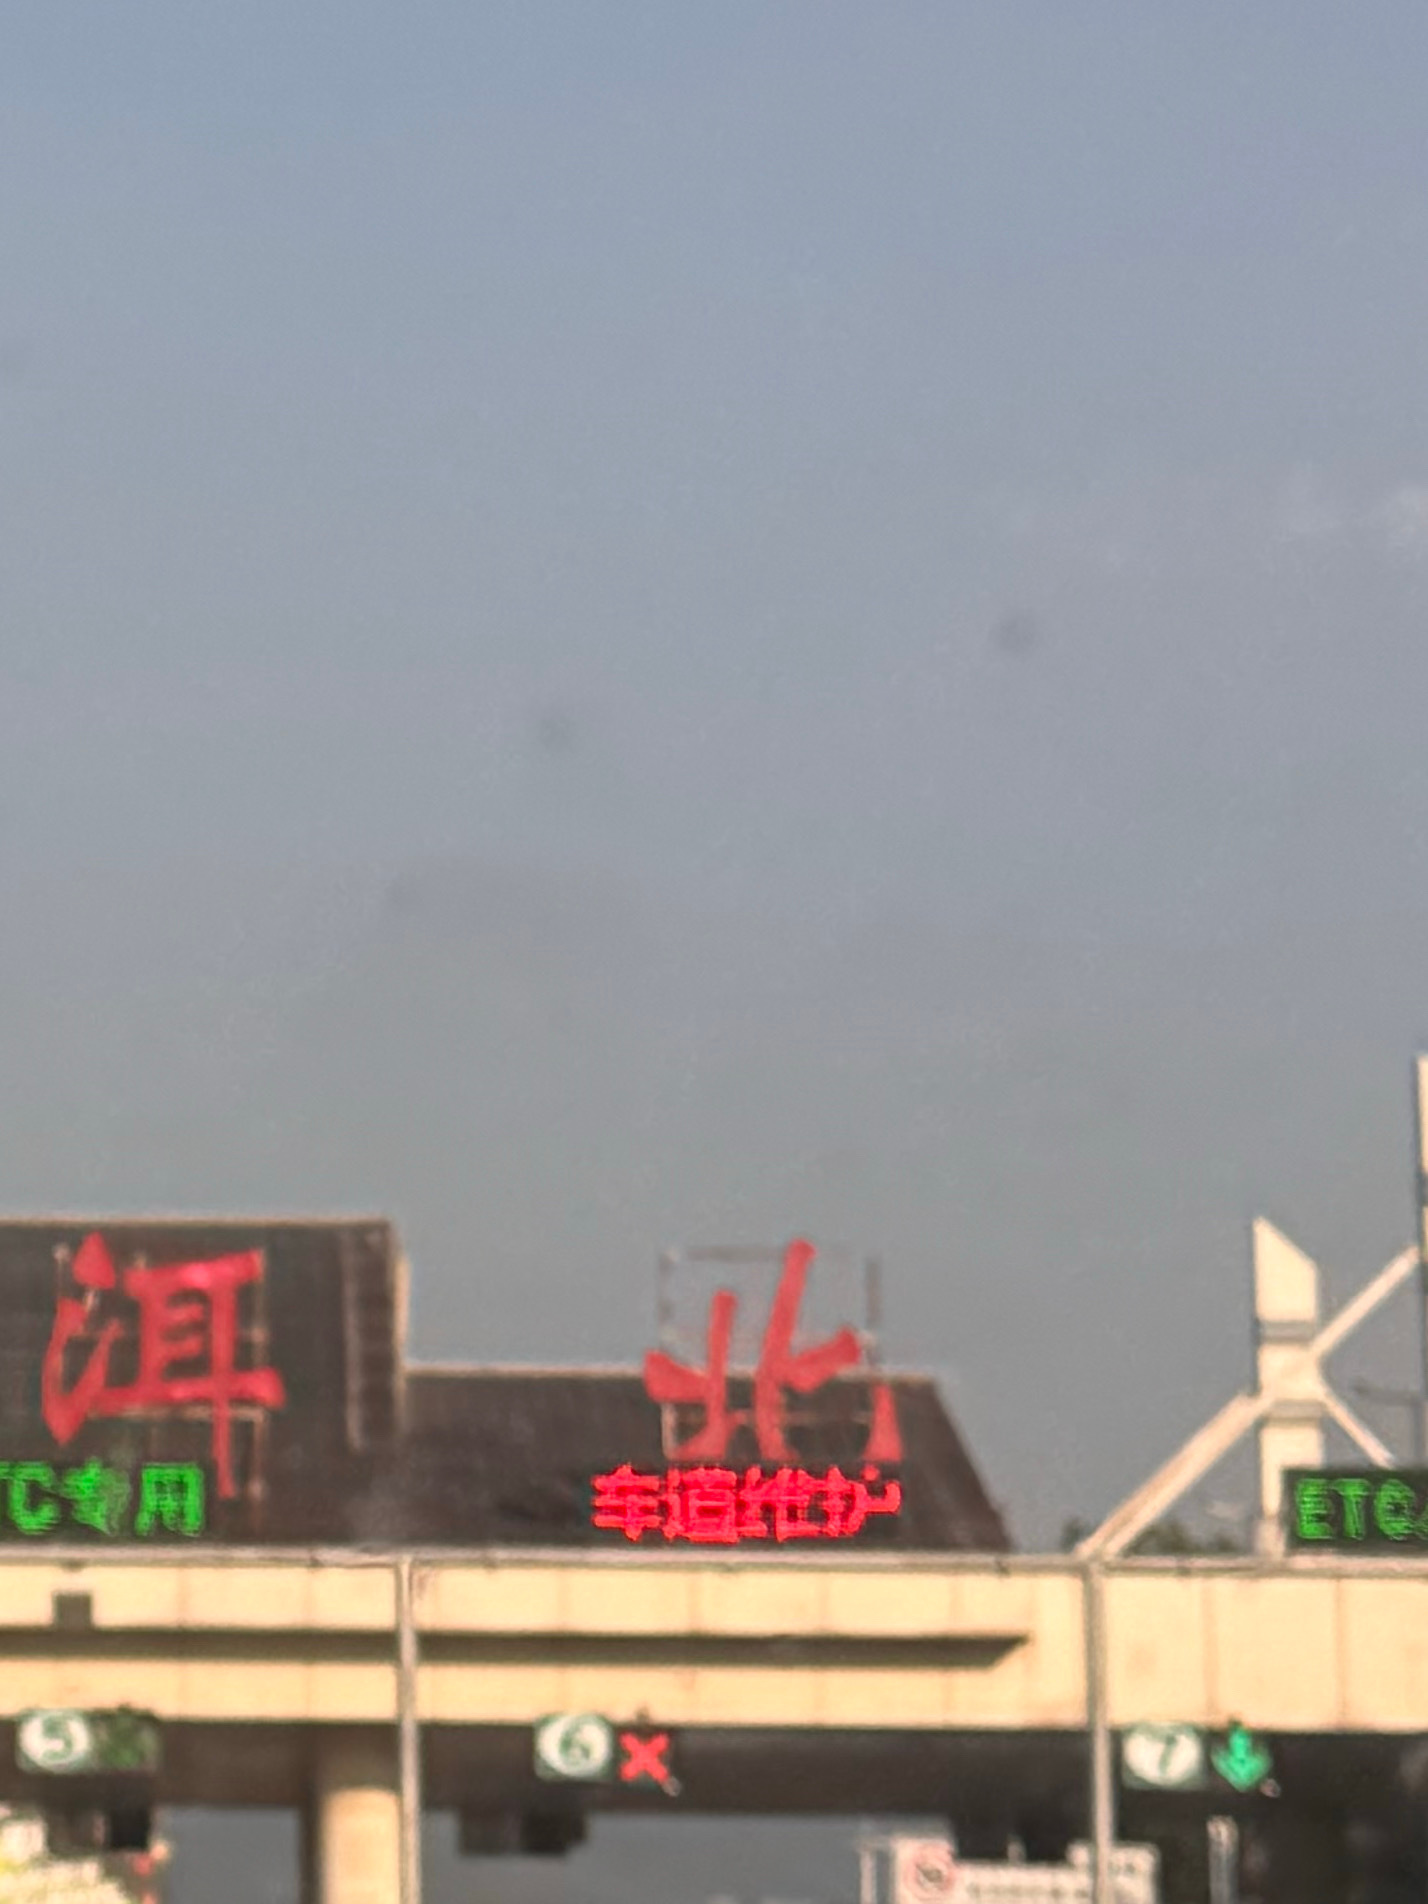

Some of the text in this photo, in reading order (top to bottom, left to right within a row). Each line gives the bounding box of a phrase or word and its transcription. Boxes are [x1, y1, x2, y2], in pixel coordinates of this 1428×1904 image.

[591, 1464, 901, 1543] 车道维护
[1296, 1477, 1428, 1540] ETC
